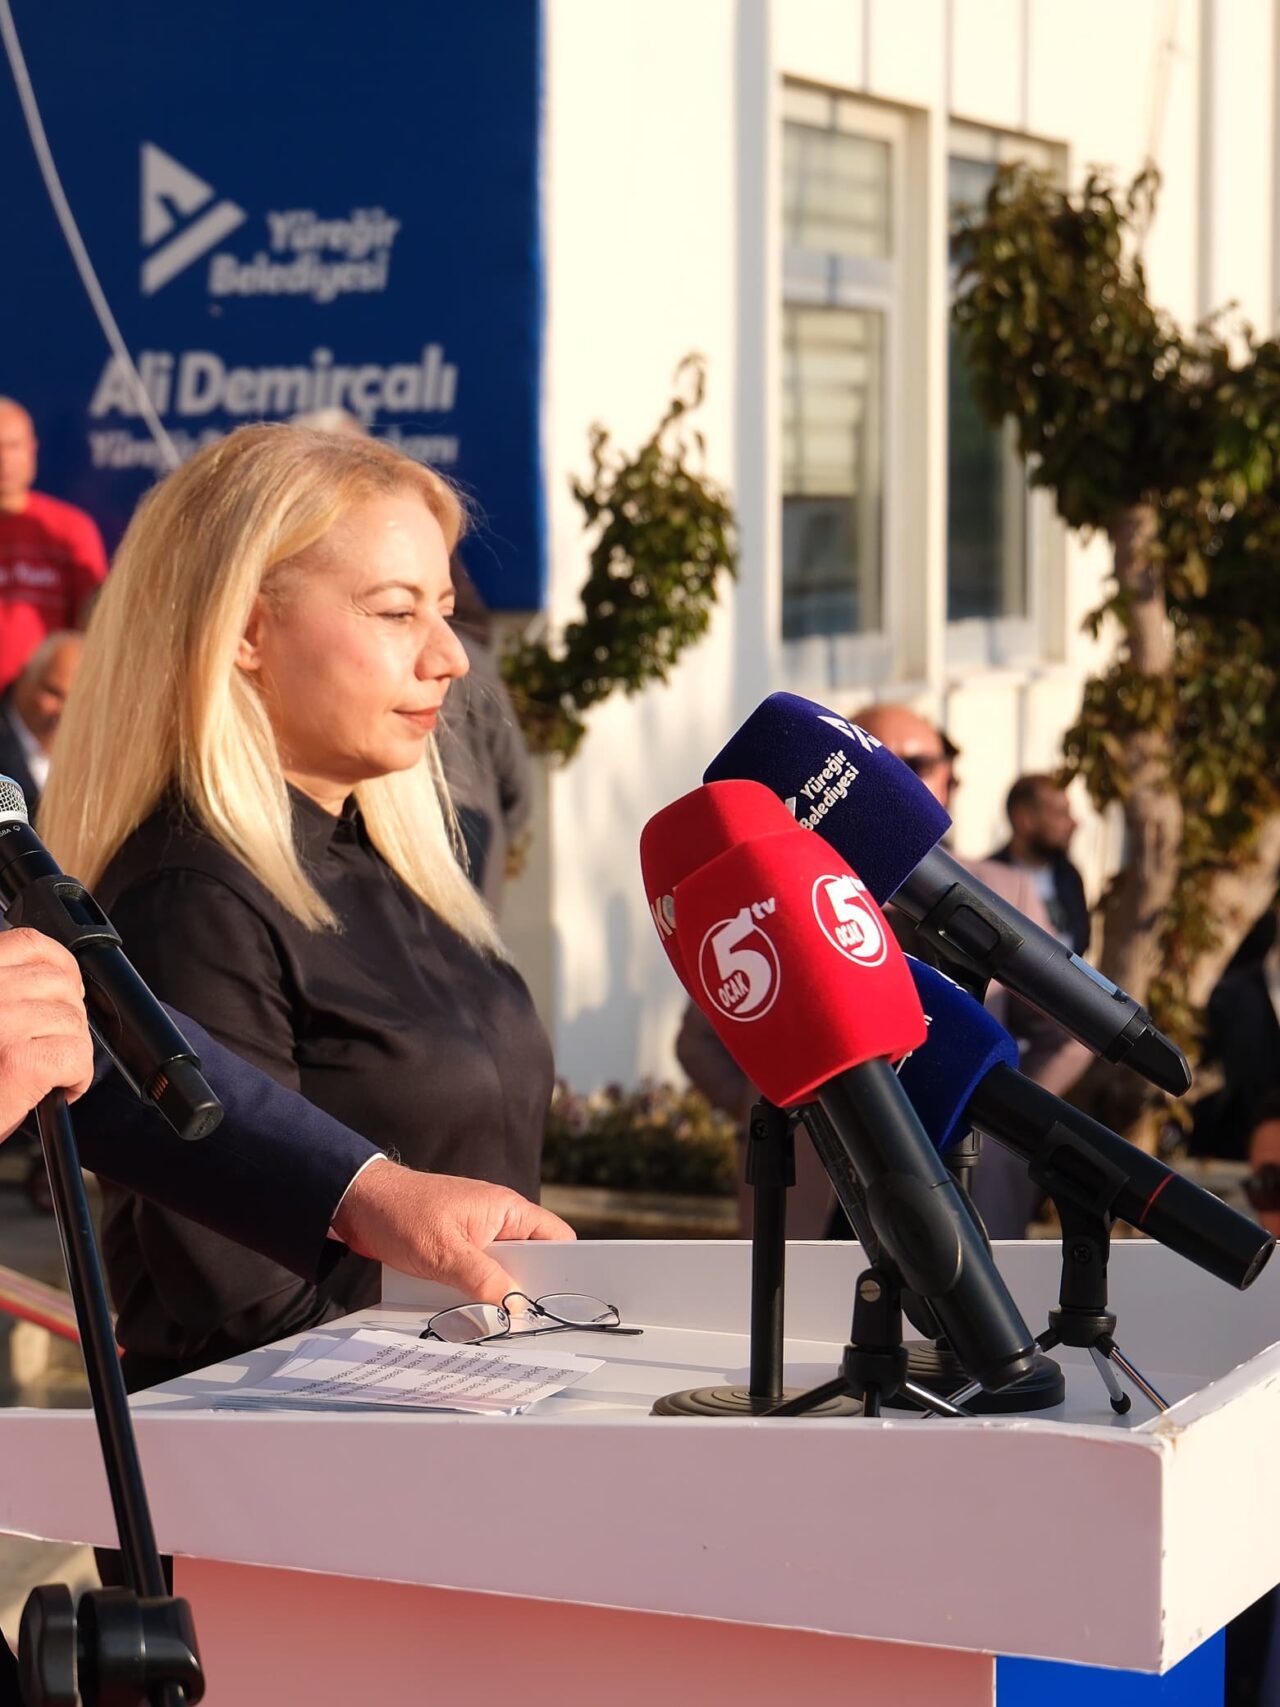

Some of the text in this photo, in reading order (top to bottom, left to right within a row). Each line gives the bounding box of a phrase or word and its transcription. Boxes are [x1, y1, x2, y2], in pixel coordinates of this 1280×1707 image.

[266, 206, 401, 257] Yüreğir
[208, 250, 389, 303] Belediyesi
[88, 342, 459, 426] Ali Demirçalı
[800, 750, 847, 800] Yüreğir
[800, 762, 860, 831] Belediyesi
[824, 874, 881, 958] 5
[711, 897, 776, 1014] 5 tv
[718, 971, 749, 1008] OCAK
